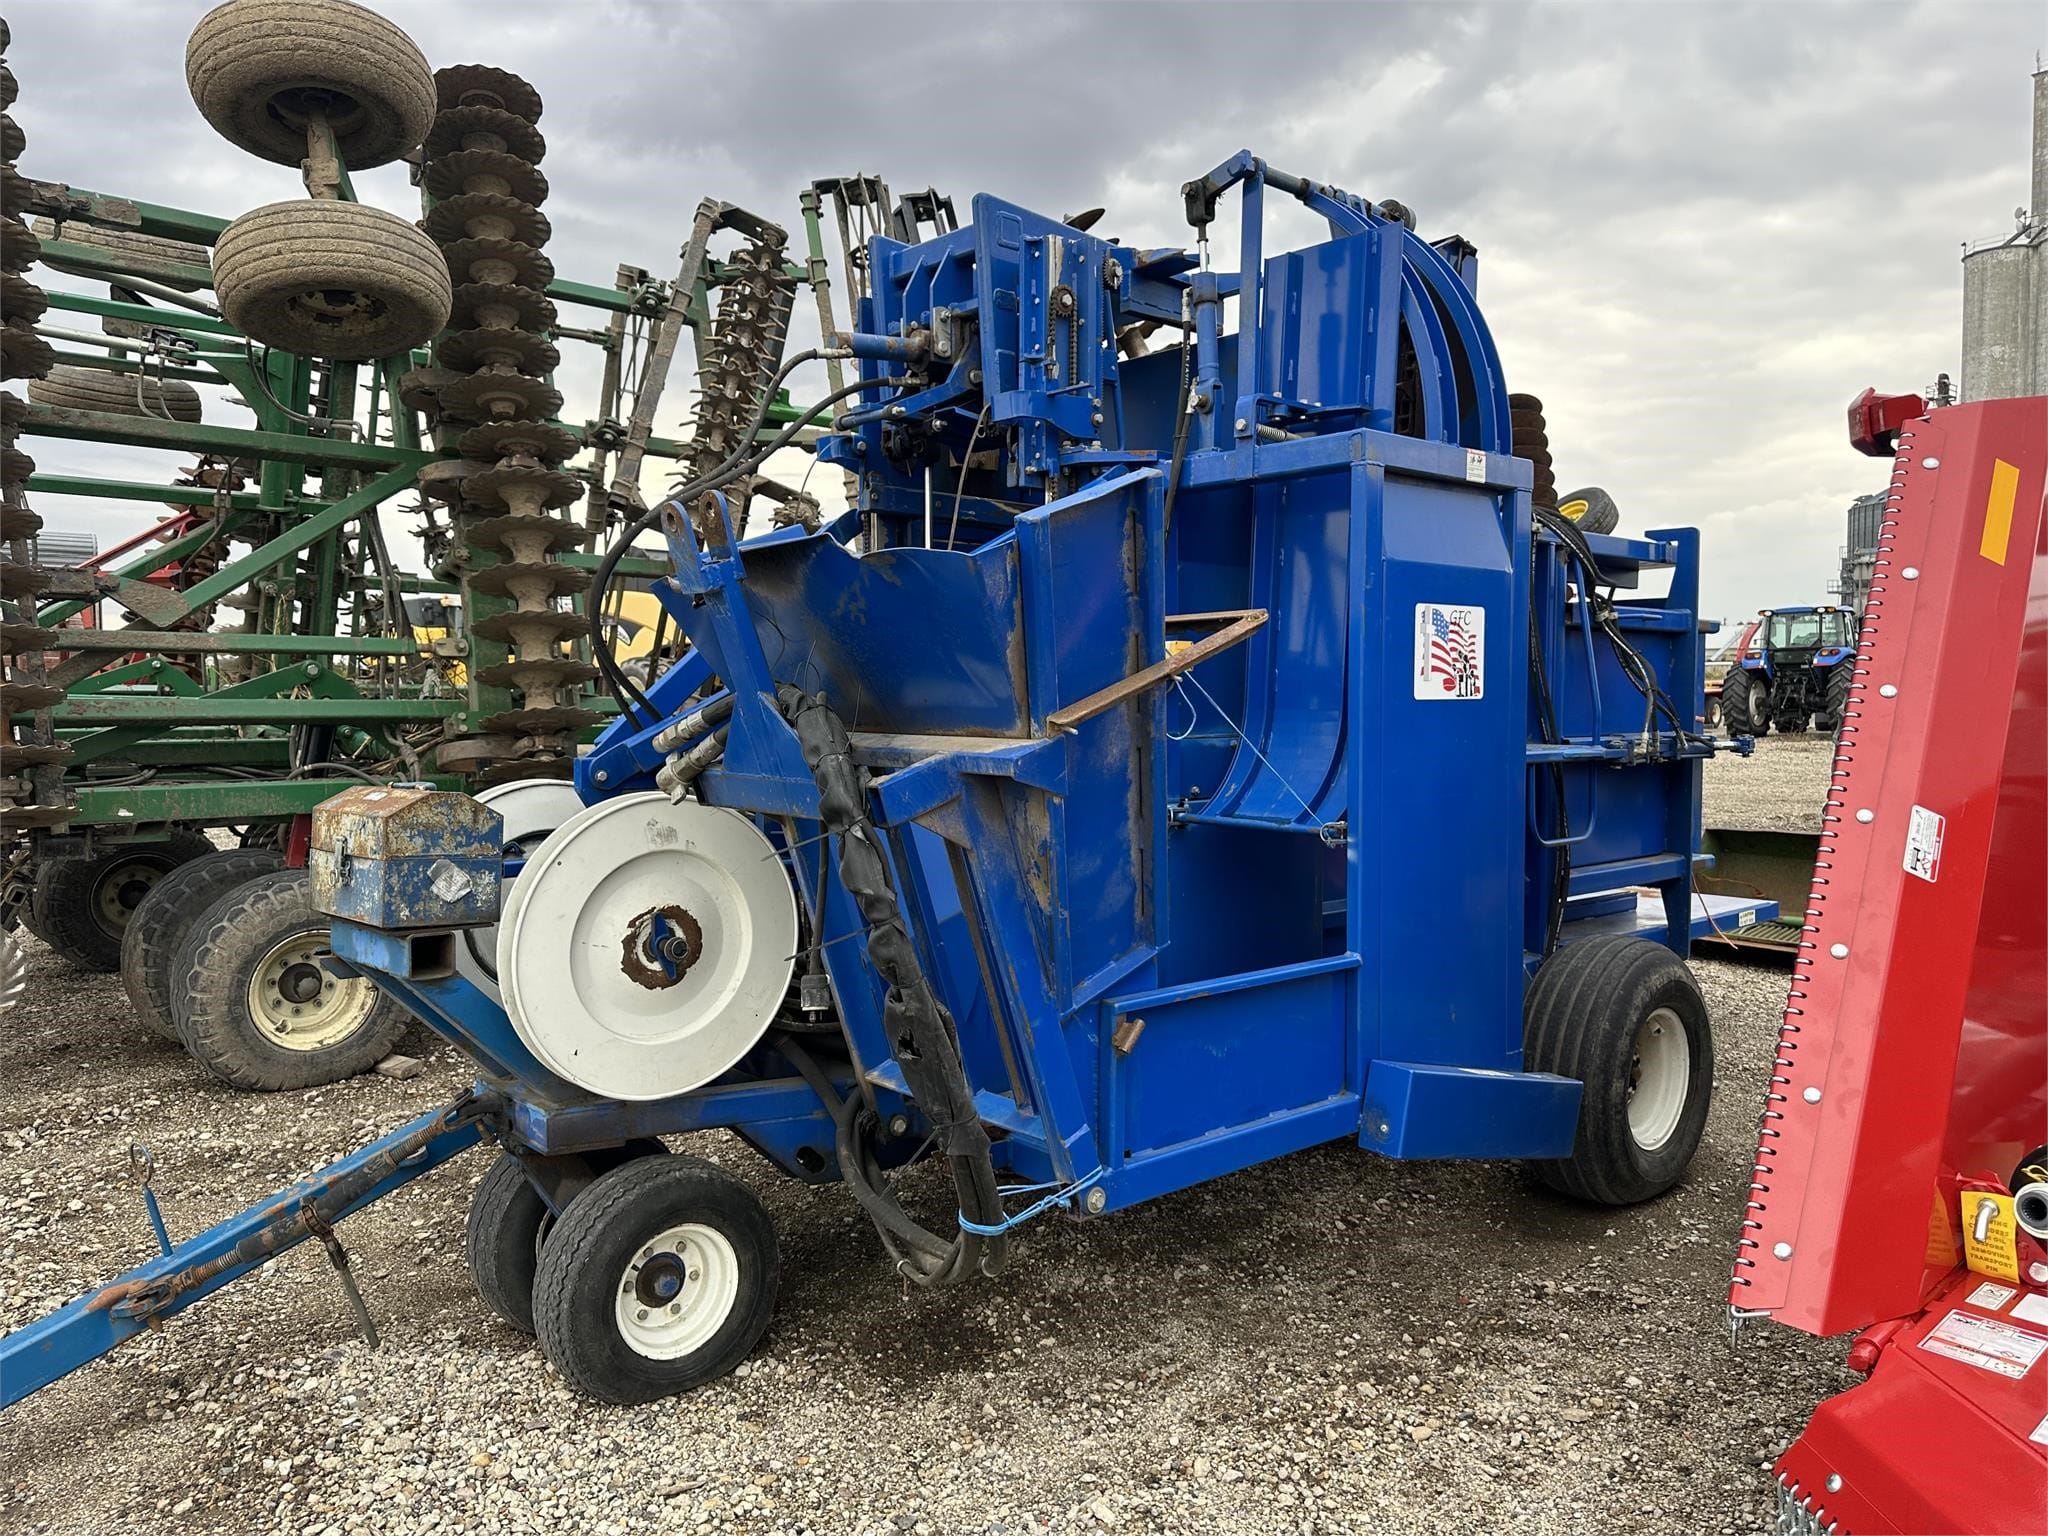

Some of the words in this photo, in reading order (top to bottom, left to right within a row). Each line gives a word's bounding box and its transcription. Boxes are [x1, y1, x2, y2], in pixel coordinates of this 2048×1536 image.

[1450, 610, 1472, 626] GFC
[1971, 1246, 2010, 1260] REMOVING
[1970, 1253, 2013, 1270] TRANSPORT
[1985, 1264, 1998, 1273] PIN
